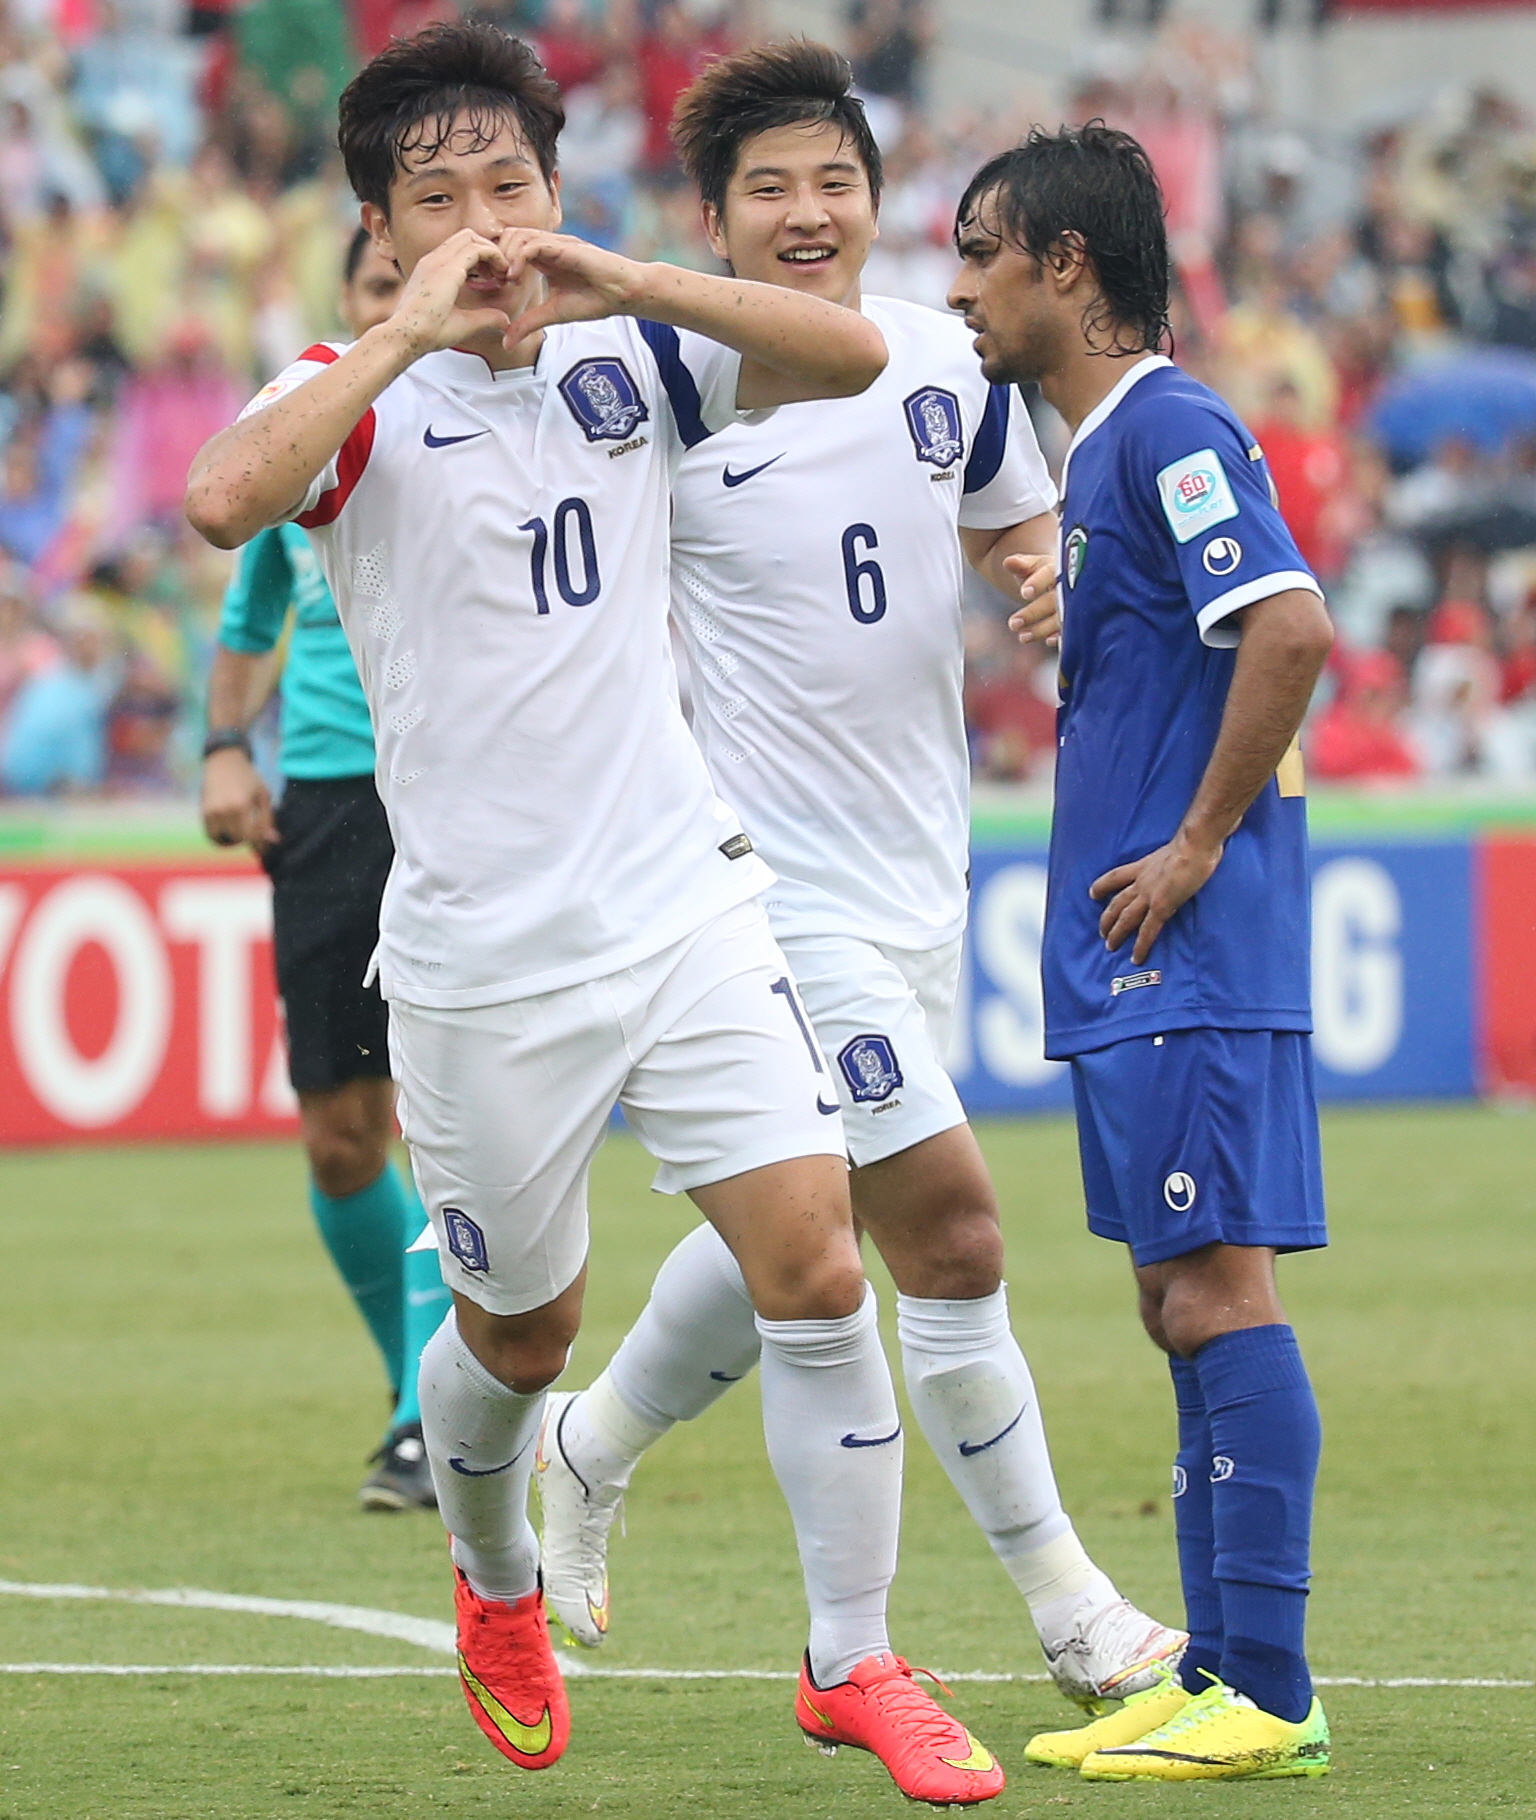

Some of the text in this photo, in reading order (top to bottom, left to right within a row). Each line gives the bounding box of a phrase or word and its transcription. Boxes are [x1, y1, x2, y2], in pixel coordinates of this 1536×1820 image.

[607, 436, 649, 459] KOREA
[1179, 473, 1206, 498] 60
[516, 496, 601, 614] 10
[841, 522, 887, 624] 6
[871, 1098, 902, 1116] KOREA
